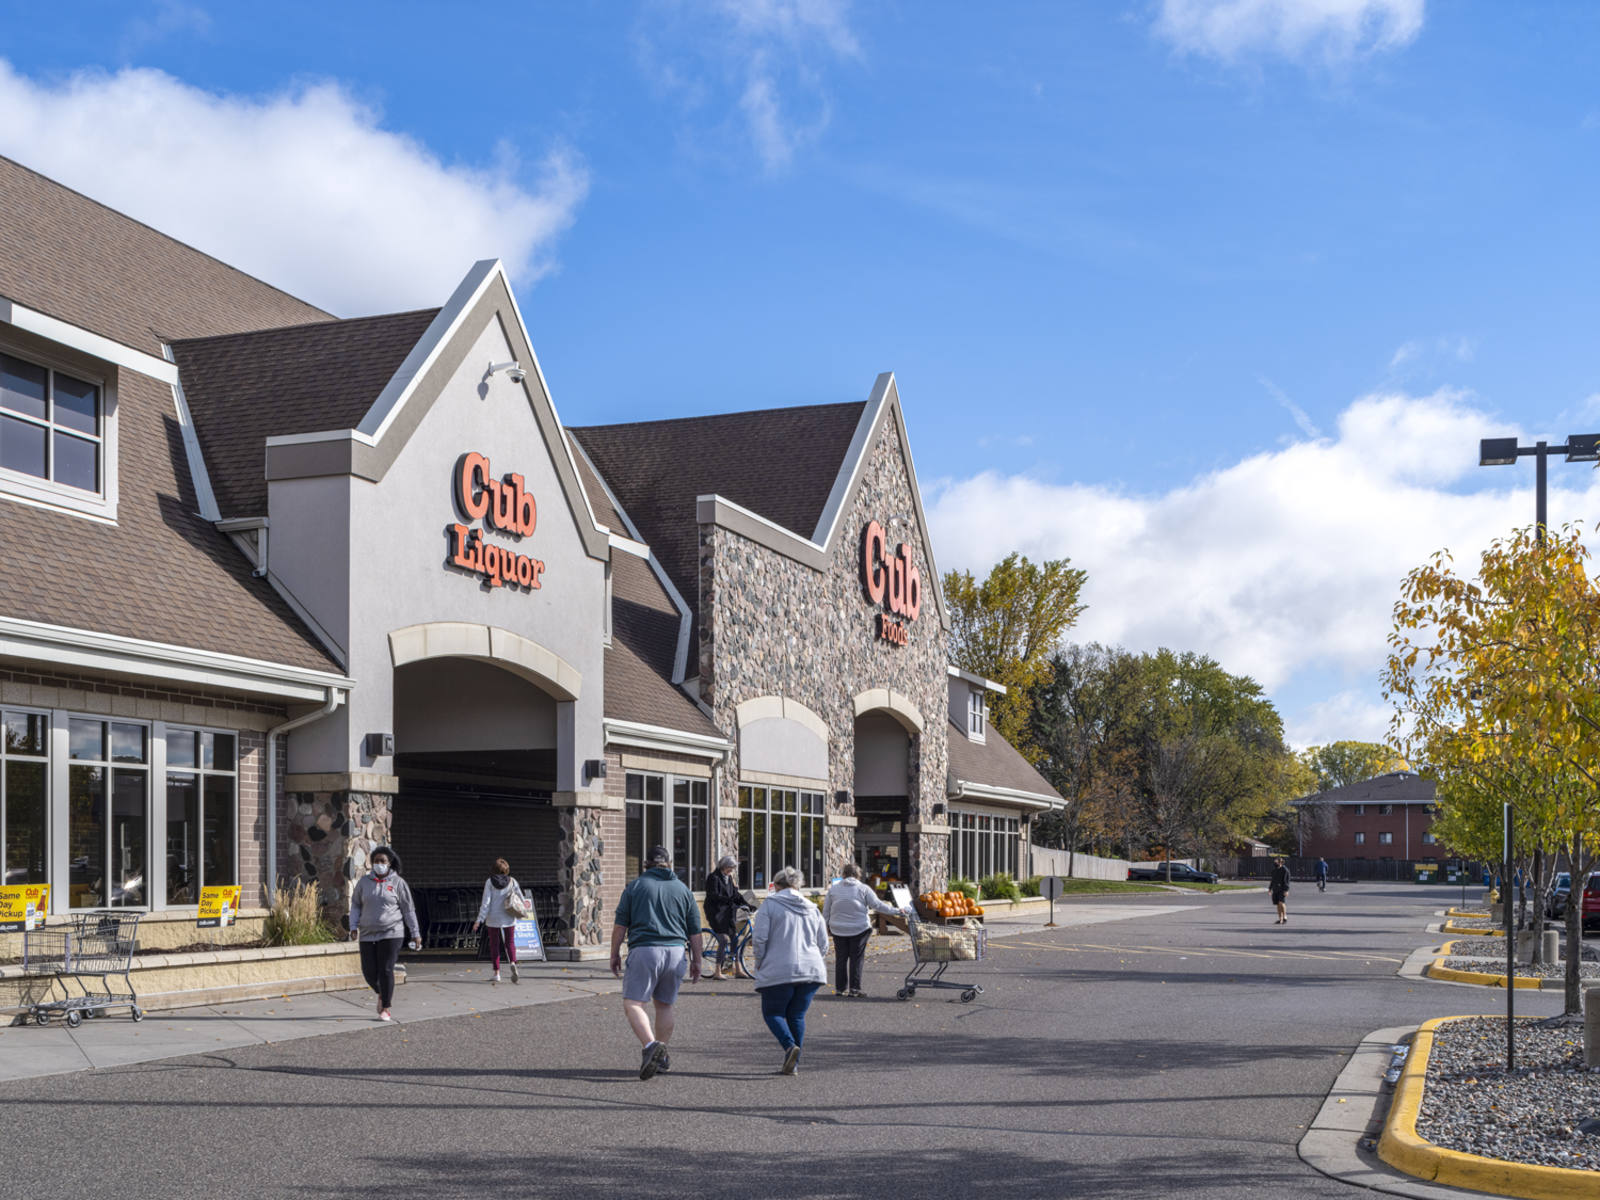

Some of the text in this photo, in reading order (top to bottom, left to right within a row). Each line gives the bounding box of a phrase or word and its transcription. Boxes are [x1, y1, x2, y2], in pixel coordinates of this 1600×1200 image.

[457, 452, 537, 538] Cub
[450, 523, 545, 590] Liquor
[862, 520, 921, 621] Cub
[879, 614, 908, 646] Foods
